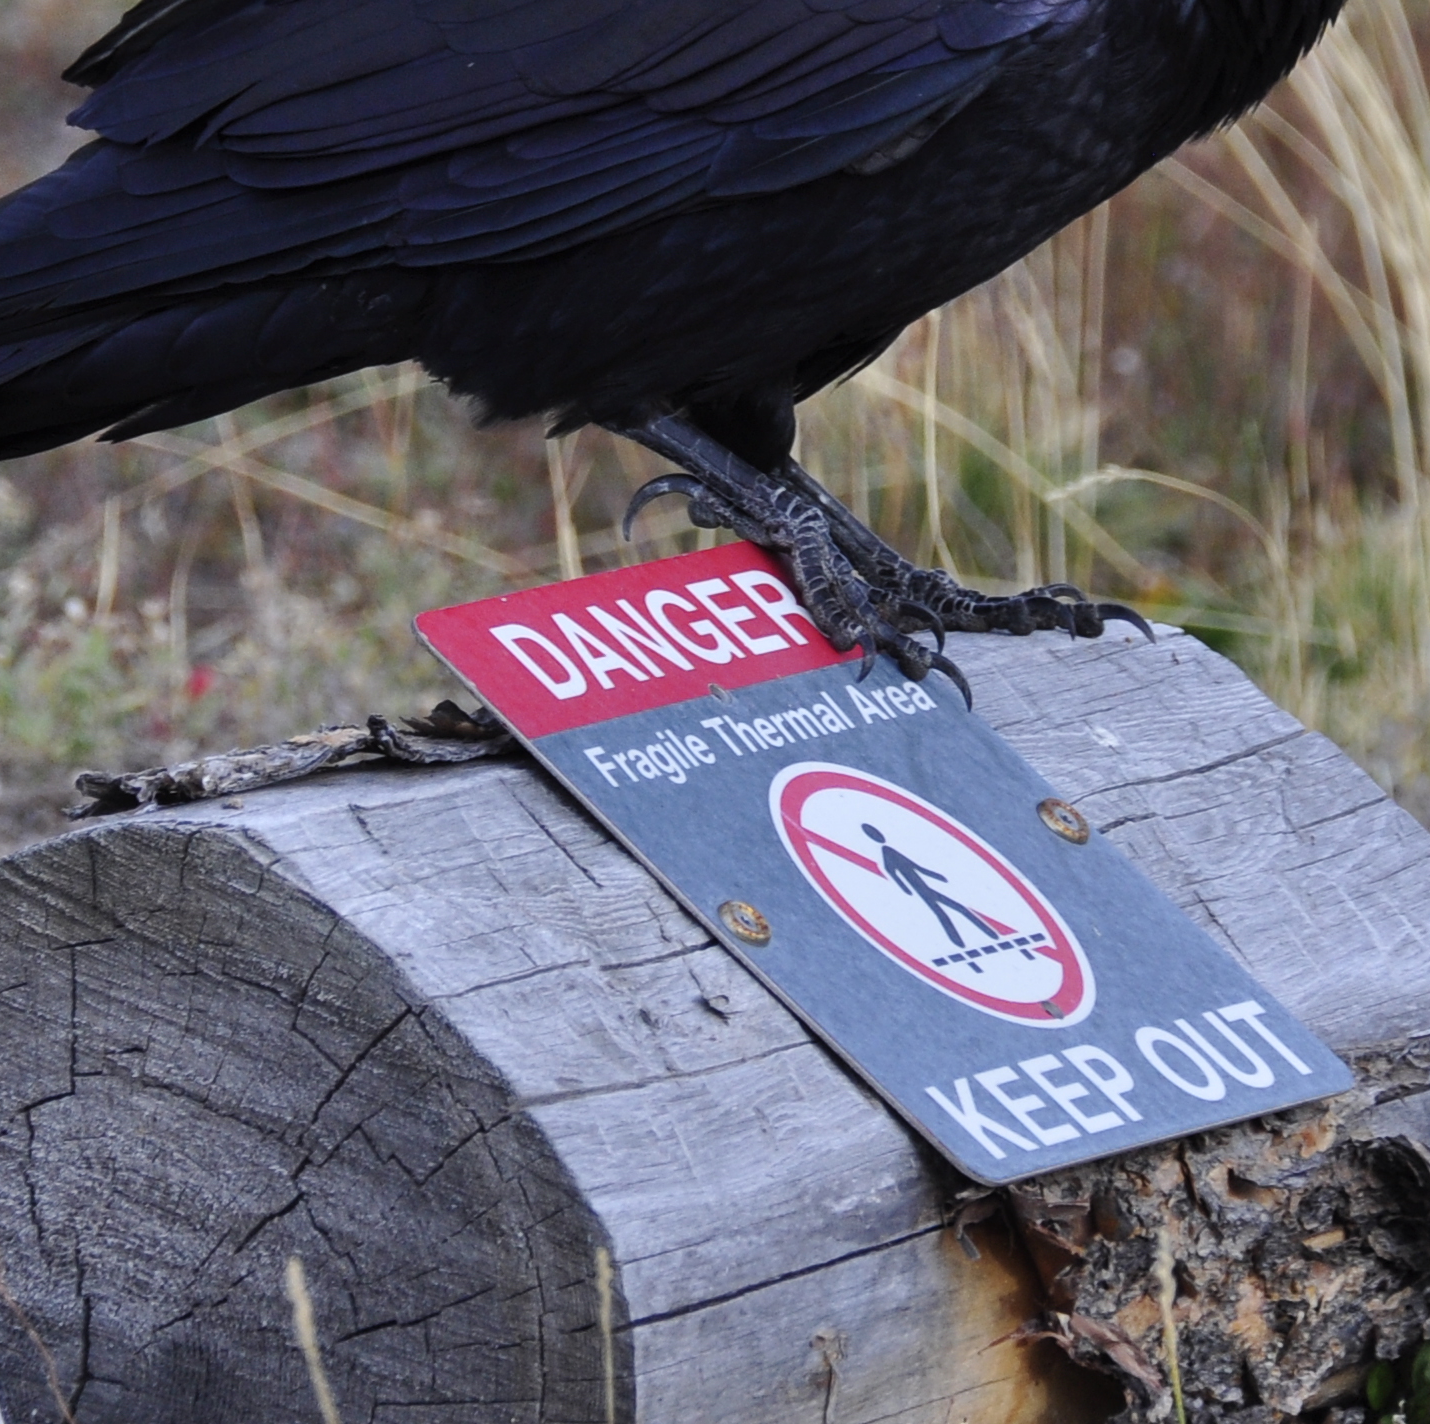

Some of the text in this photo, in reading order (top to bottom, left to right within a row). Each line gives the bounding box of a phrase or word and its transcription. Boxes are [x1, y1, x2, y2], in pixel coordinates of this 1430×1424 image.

[488, 569, 829, 701] DANGER
[583, 680, 937, 788] Fragile Thermal Area
[924, 1000, 1314, 1160] KEEP OUT
